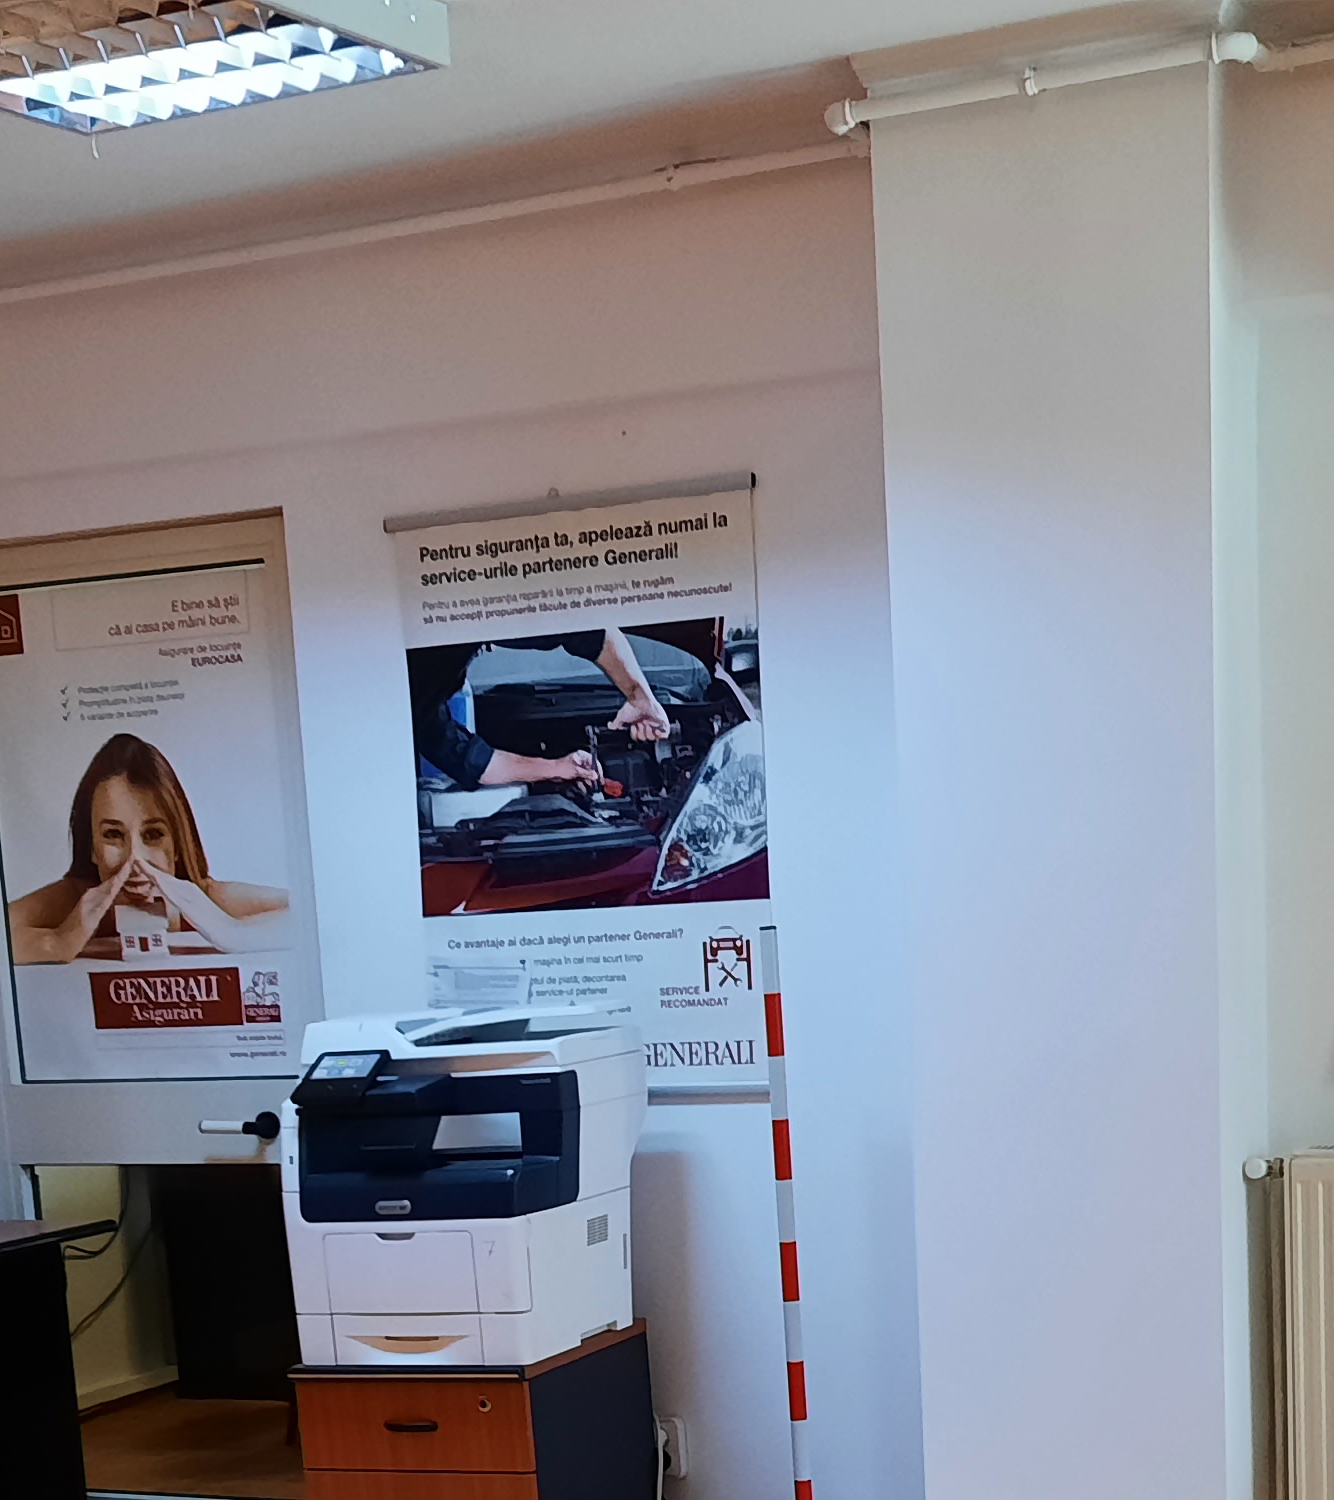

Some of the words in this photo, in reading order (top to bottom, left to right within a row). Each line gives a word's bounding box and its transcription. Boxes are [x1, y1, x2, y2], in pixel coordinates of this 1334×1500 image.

[418, 543, 471, 563] Pentru
[553, 531, 575, 549] ta,
[577, 519, 654, 547] apelează
[657, 512, 709, 536] numai
[712, 511, 729, 529] la
[420, 561, 519, 587] service-urile
[521, 553, 599, 579] partenere
[603, 541, 679, 567] Generali!
[569, 599, 582, 609] de
[135, 622, 160, 634] casa
[161, 620, 176, 632] pe
[190, 653, 244, 667] EUROCASA
[447, 938, 463, 950] Ce
[463, 936, 506, 951] avantaje
[507, 935, 517, 947] ai
[518, 934, 545, 947] dacă
[546, 932, 571, 948] alegi
[573, 934, 586, 945] un
[587, 931, 631, 946] partener
[633, 927, 685, 942] Generali?
[108, 974, 222, 1005] GENERALI
[658, 985, 701, 997] SERVICE
[660, 996, 730, 1009] RECOMANDAT
[130, 1002, 204, 1026] Asigurări
